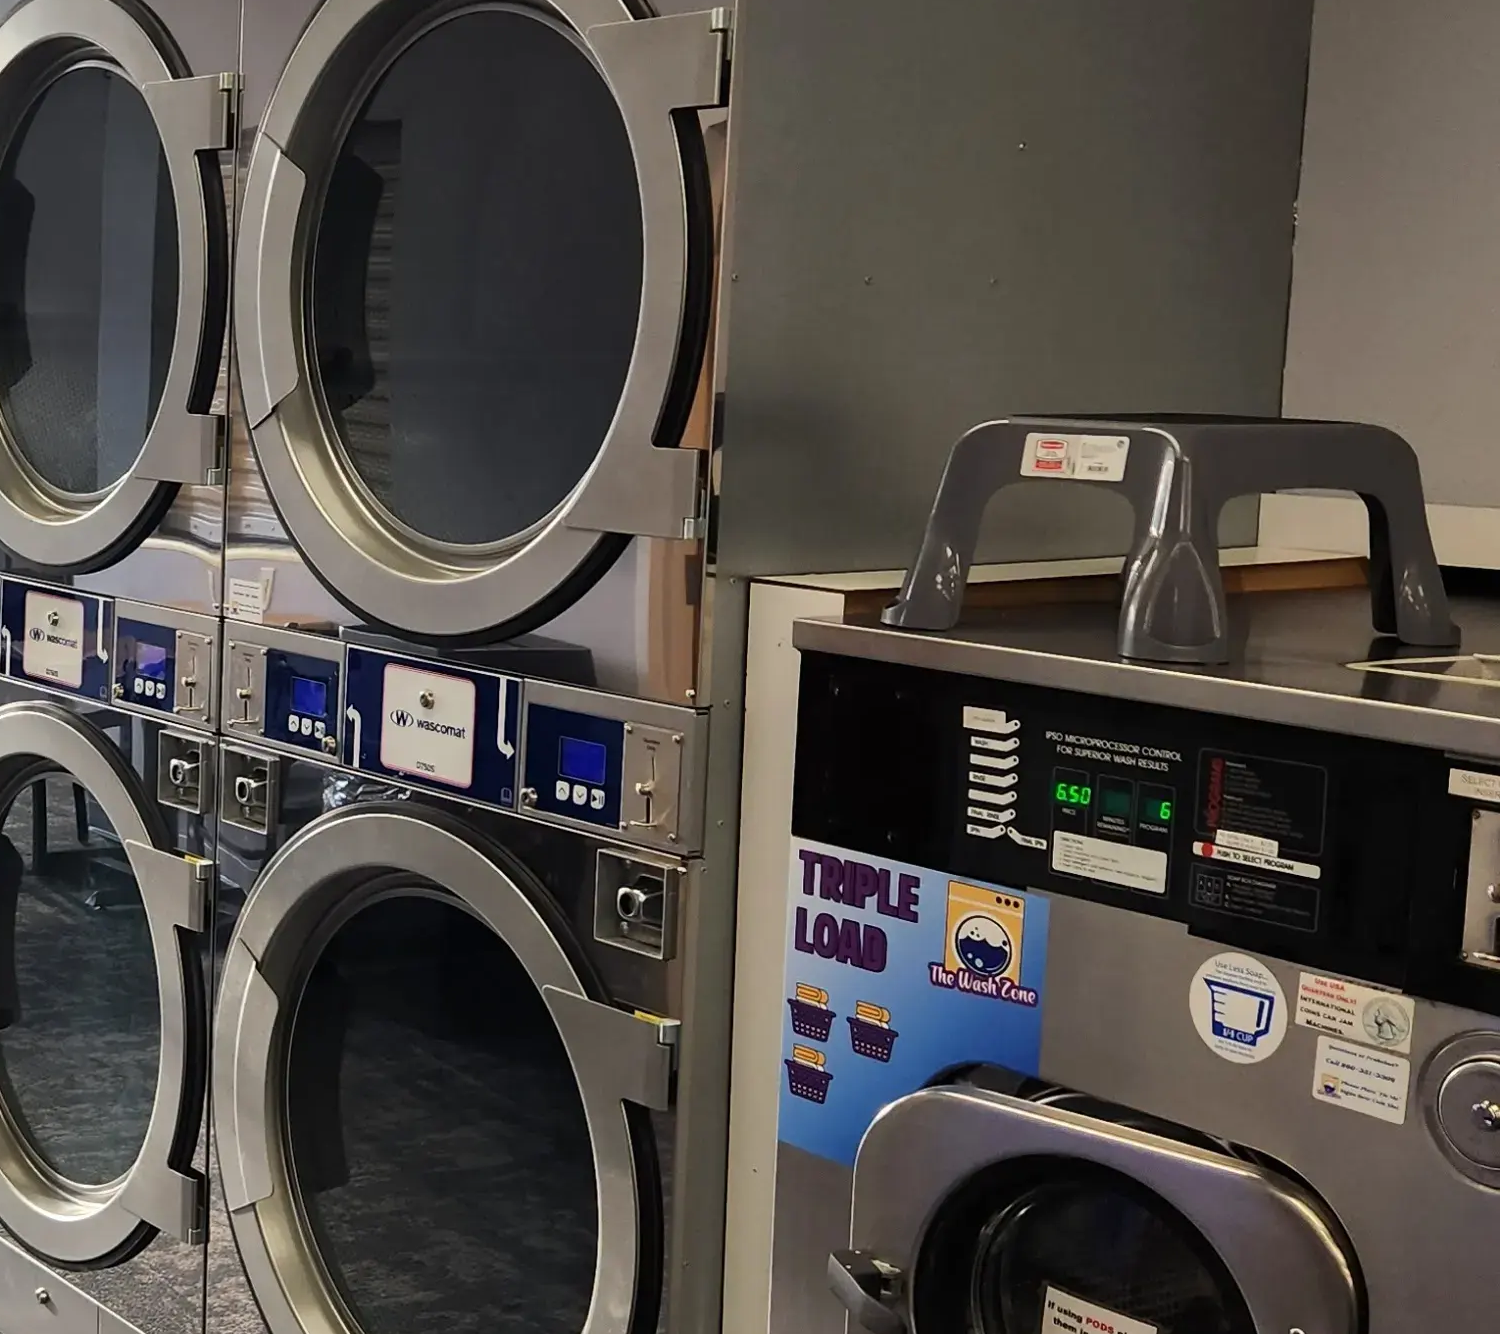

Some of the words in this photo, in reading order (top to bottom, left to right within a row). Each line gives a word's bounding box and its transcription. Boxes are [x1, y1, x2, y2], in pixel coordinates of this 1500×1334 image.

[416, 718, 466, 740] wascomat
[1056, 744, 1074, 756] FOR
[1074, 747, 1112, 762] SUPERIOR
[1112, 754, 1137, 767] WASH
[1137, 758, 1169, 772] RESULTS
[1064, 734, 1140, 754] MICROPROCESSOR
[1141, 746, 1182, 762] CONTROL
[1159, 801, 1172, 819] 6
[799, 849, 920, 923] TRIPLE
[794, 906, 887, 973] LOAD
[1214, 960, 1228, 971] Use
[929, 964, 955, 987] The
[958, 968, 997, 997] Wash
[1000, 975, 1037, 1005] Zone
[1236, 1031, 1254, 1043] CUP
[1047, 1300, 1055, 1309] If
[1057, 1305, 1082, 1323] using
[1085, 1317, 1114, 1334] PODS
[1053, 1317, 1077, 1334] them
